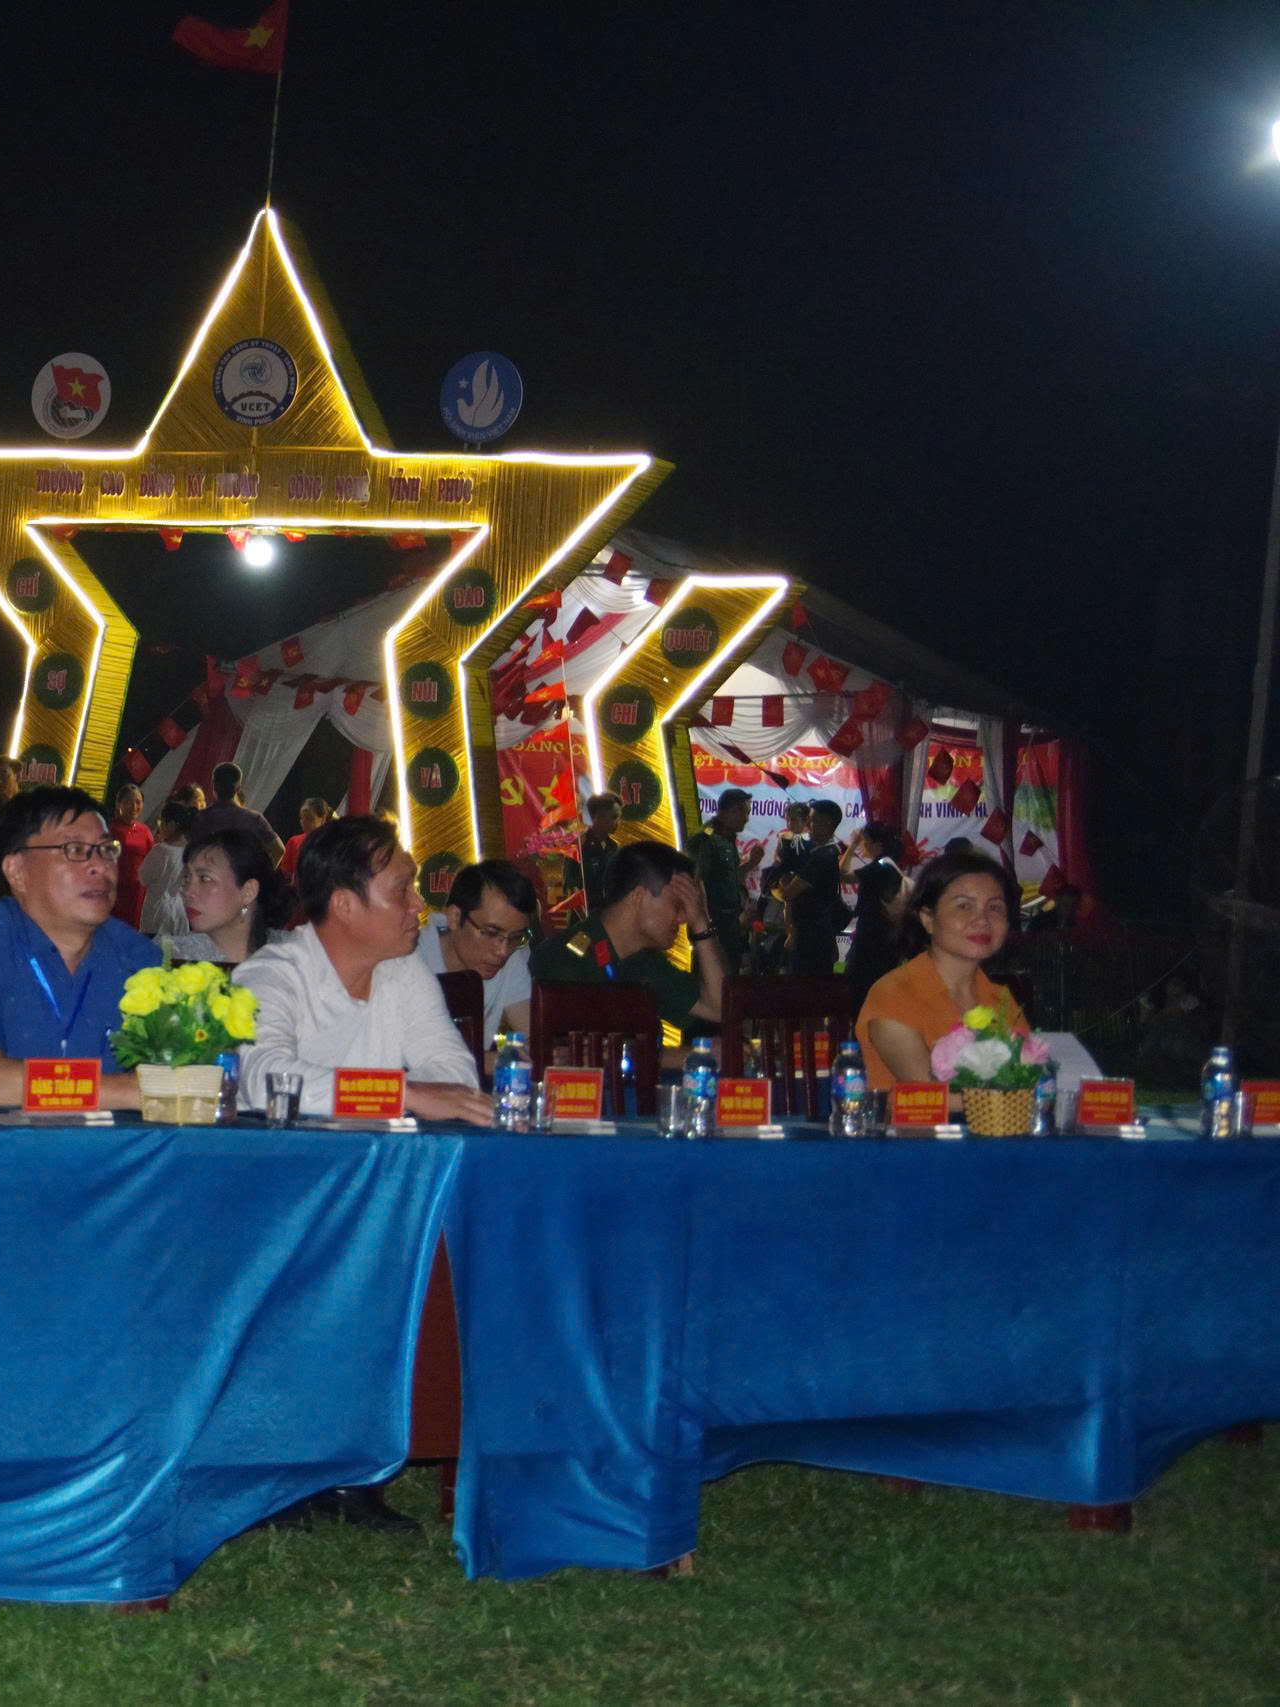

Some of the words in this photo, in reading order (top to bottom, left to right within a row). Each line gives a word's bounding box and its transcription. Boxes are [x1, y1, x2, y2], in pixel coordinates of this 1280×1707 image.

[241, 402, 271, 412] VCET
[99, 471, 125, 497] CAO
[411, 677, 438, 702] NÚI
[611, 700, 639, 726] CHÍ
